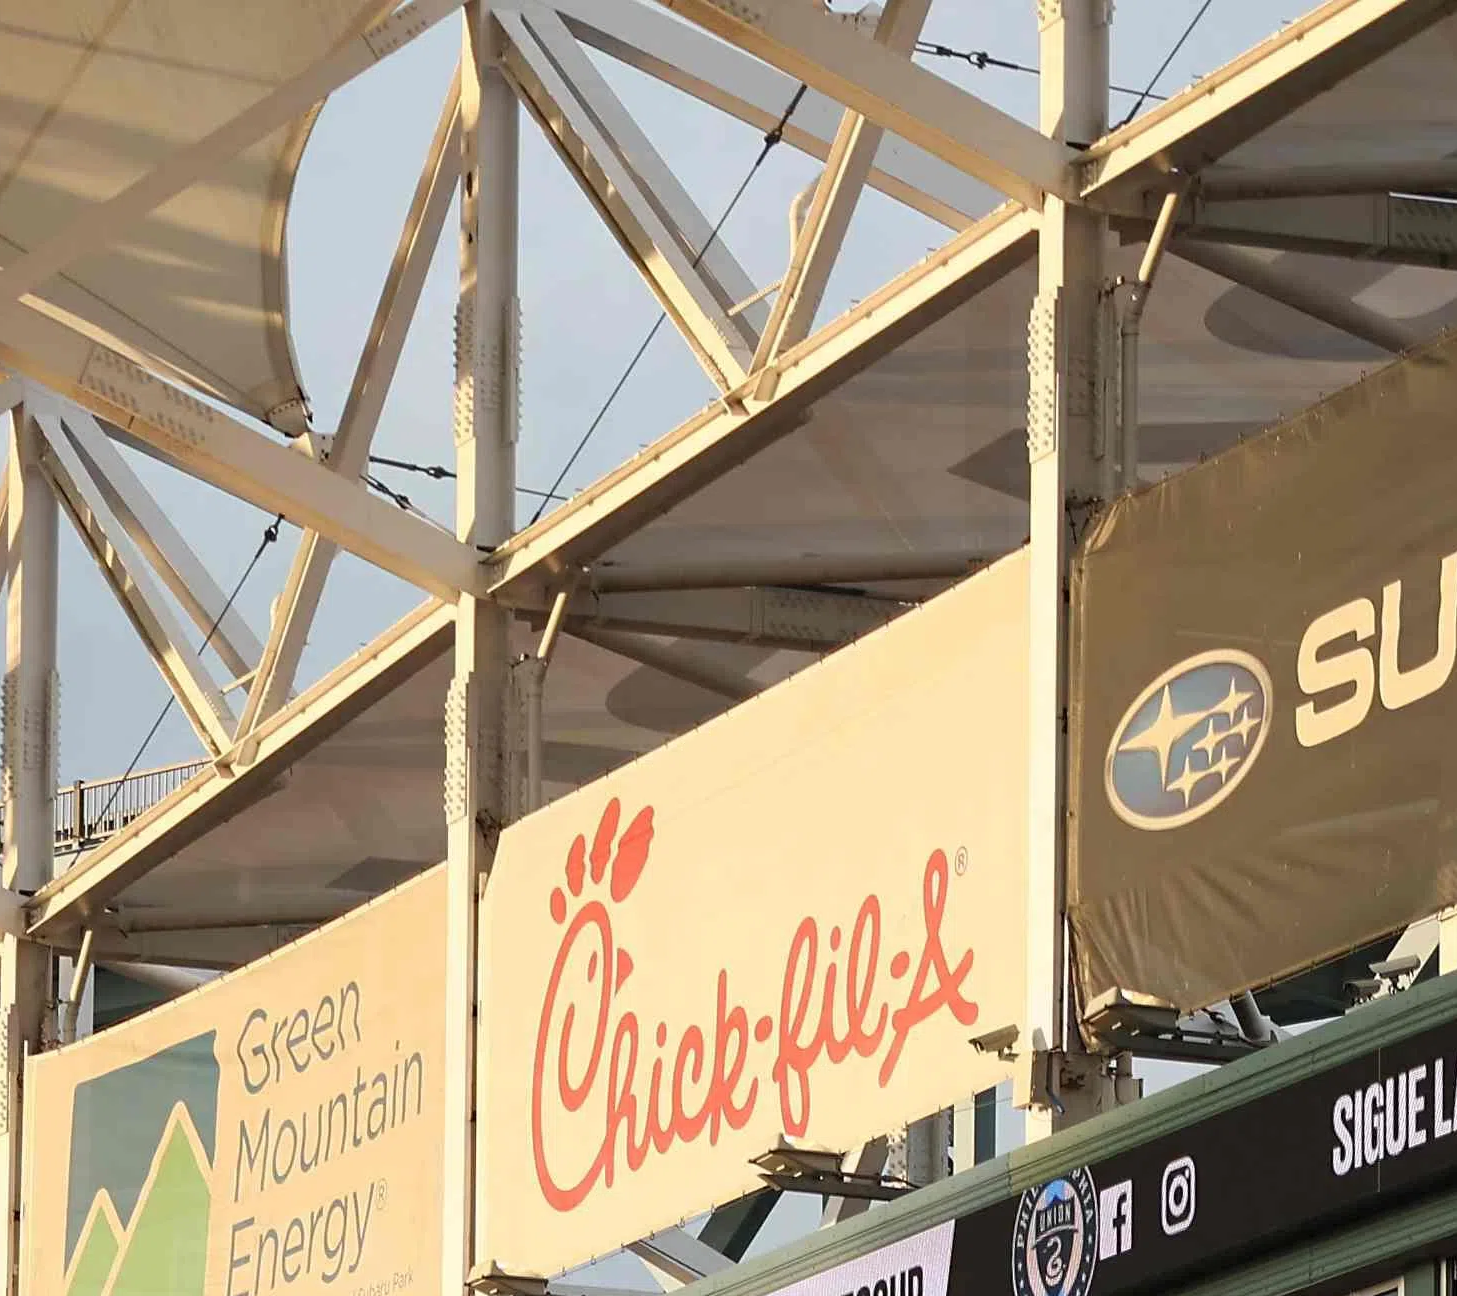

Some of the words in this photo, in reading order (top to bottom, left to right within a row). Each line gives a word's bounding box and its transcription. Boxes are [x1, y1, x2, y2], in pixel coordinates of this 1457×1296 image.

[235, 981, 361, 1095] Green
[234, 1039, 423, 1204] Mountain
[1332, 1064, 1427, 1177] SIGUE
[1038, 1204, 1071, 1233] UNION
[393, 1270, 414, 1291] Park
